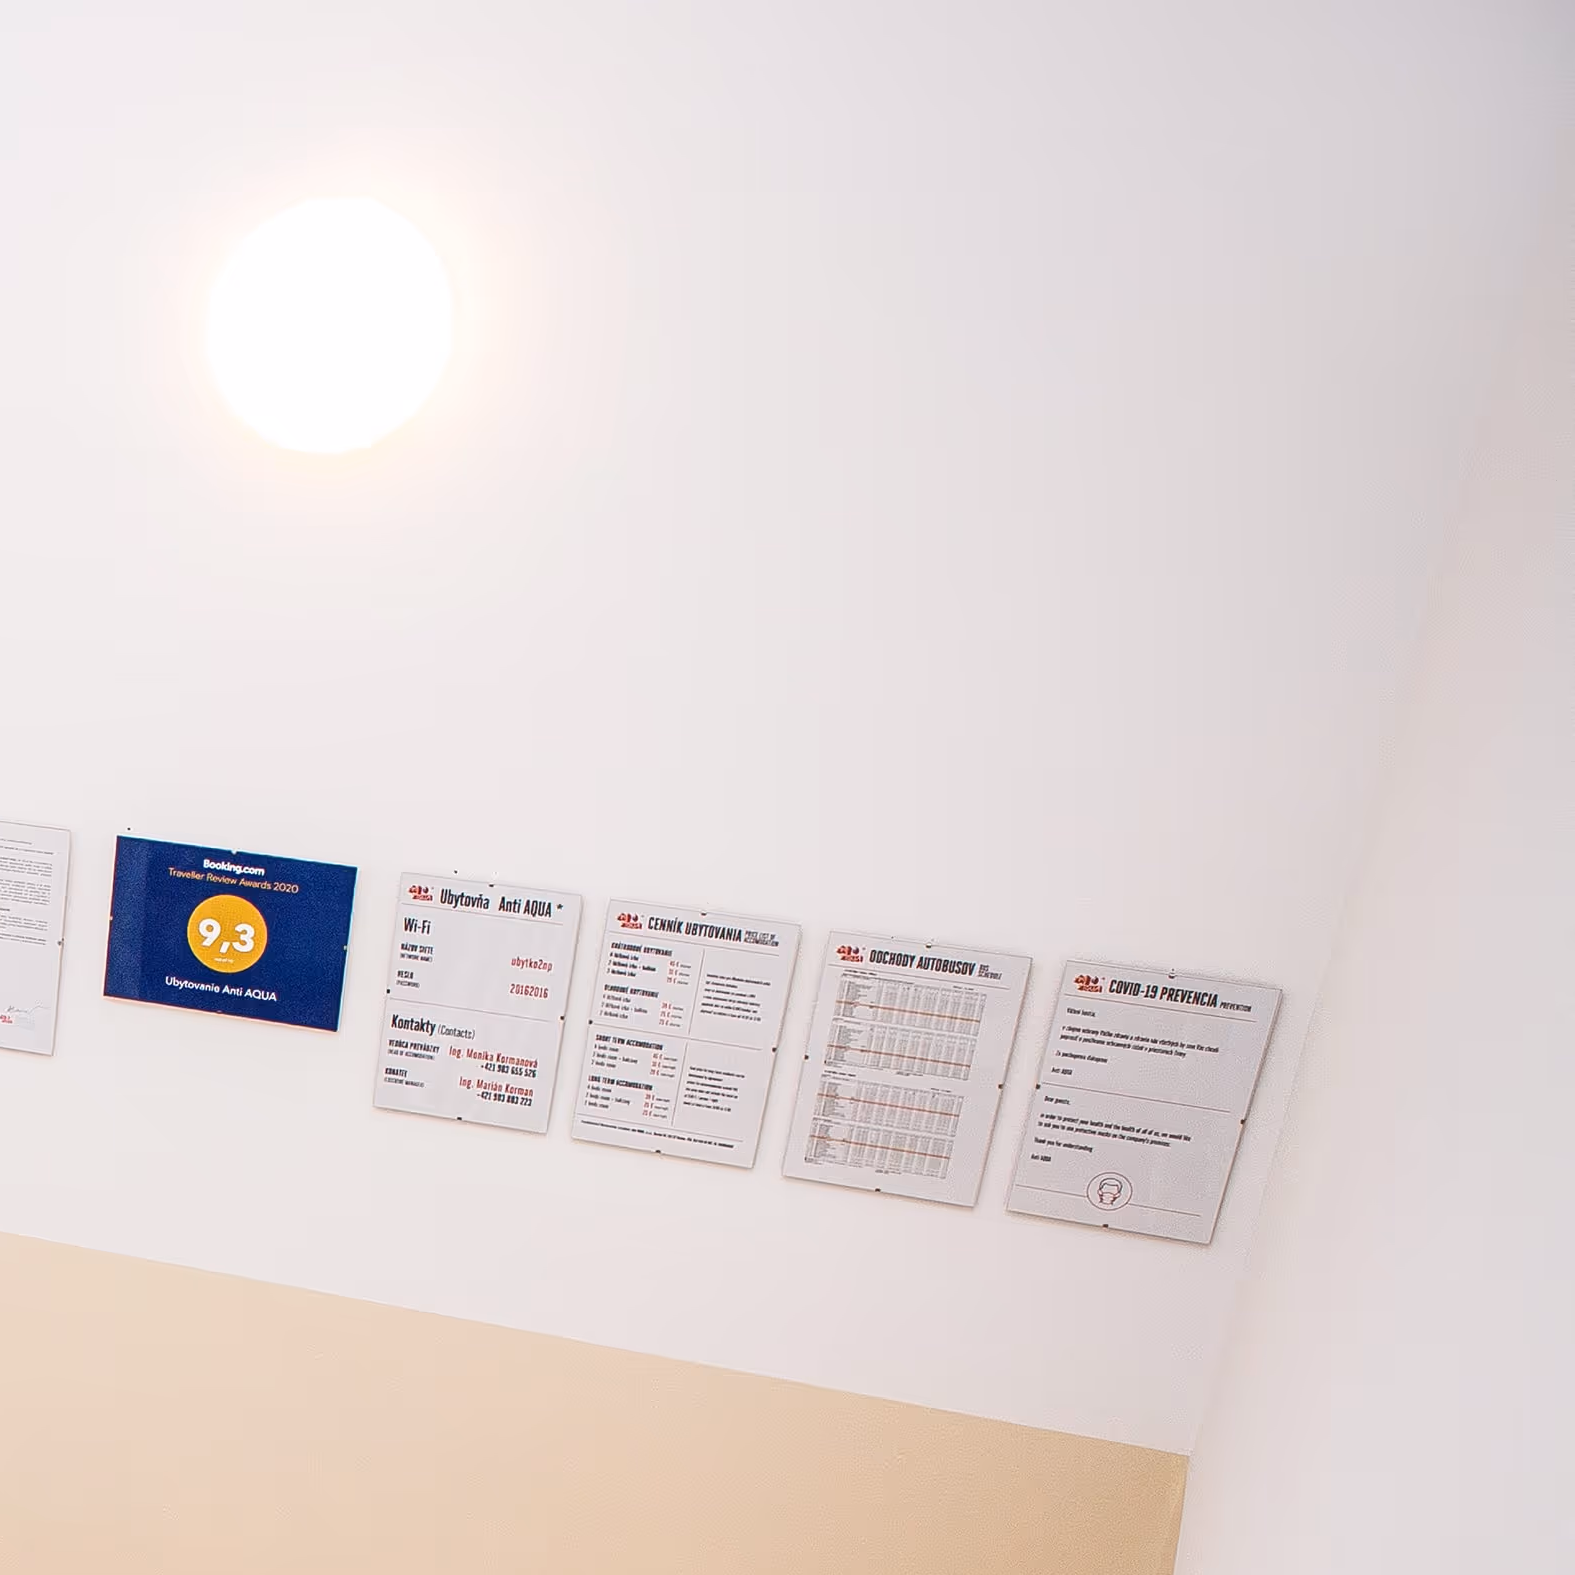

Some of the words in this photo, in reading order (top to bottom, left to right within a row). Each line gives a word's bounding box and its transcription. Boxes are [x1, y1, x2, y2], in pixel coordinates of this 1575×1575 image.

[168, 867, 204, 881] Traveller
[207, 873, 237, 885] Review
[239, 878, 271, 890] Awards
[273, 882, 299, 894] 2020
[203, 859, 265, 876] Booking.com
[440, 888, 489, 910] Ubytovňa
[499, 896, 520, 914] Anti
[524, 900, 551, 917] AQUA
[198, 918, 255, 954] 9,3
[404, 917, 431, 934] Wi-Fi
[647, 916, 682, 934] CENNÍK
[685, 923, 742, 943] UBYTOVANIA
[869, 949, 915, 968] ODCHODY
[916, 956, 976, 976] AUTOBUSOV
[165, 976, 219, 993] Ubytovanie
[222, 985, 242, 997] Anti
[244, 989, 277, 1002] AQUA
[510, 984, 548, 998] 20162016
[1109, 979, 1157, 999] COVID-19
[1159, 986, 1218, 1008] PREVENCIA
[391, 1014, 436, 1036] Kontakty
[438, 1025, 475, 1040] (Contacts)
[449, 1045, 463, 1059] Ing.
[466, 1048, 493, 1062] Monika
[496, 1053, 538, 1068] Kormanová
[459, 1076, 473, 1089] Ing.
[477, 1079, 503, 1092] Marián
[505, 1084, 533, 1097] Korman
